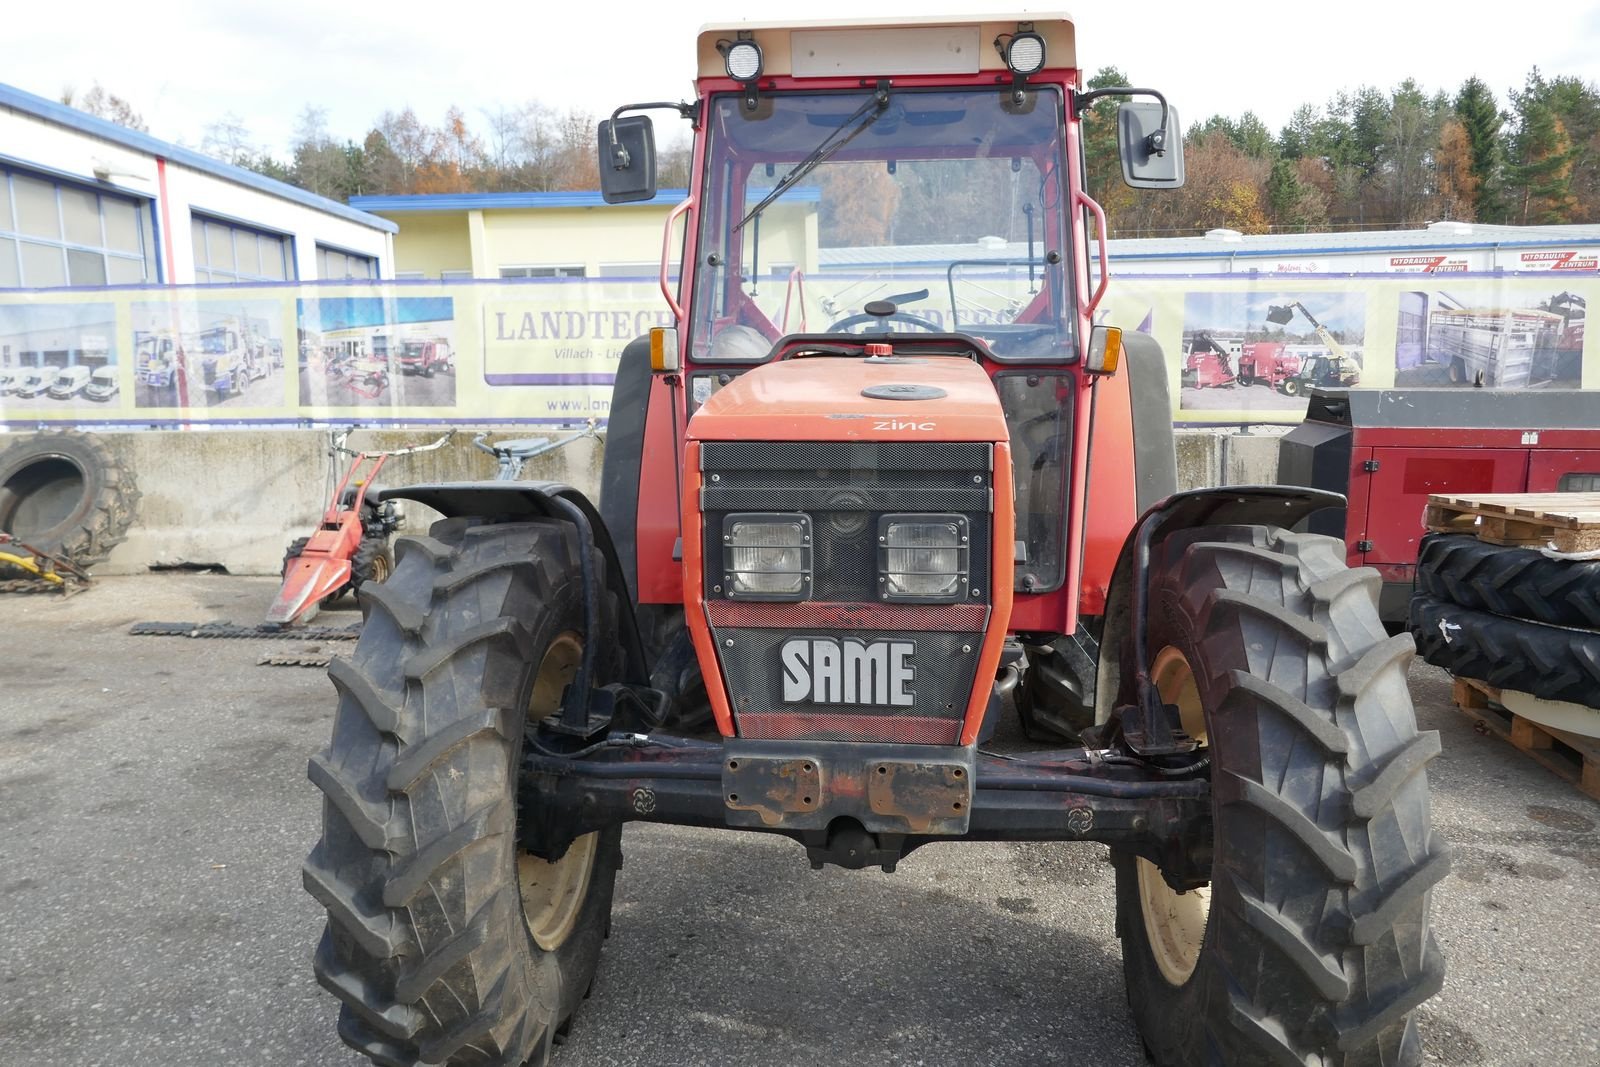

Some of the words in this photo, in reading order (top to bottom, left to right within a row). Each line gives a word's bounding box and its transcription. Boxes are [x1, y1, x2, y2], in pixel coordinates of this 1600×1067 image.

[554, 347, 593, 359] Villach
[872, 419, 937, 431] zinc
[780, 638, 915, 706] SAME
